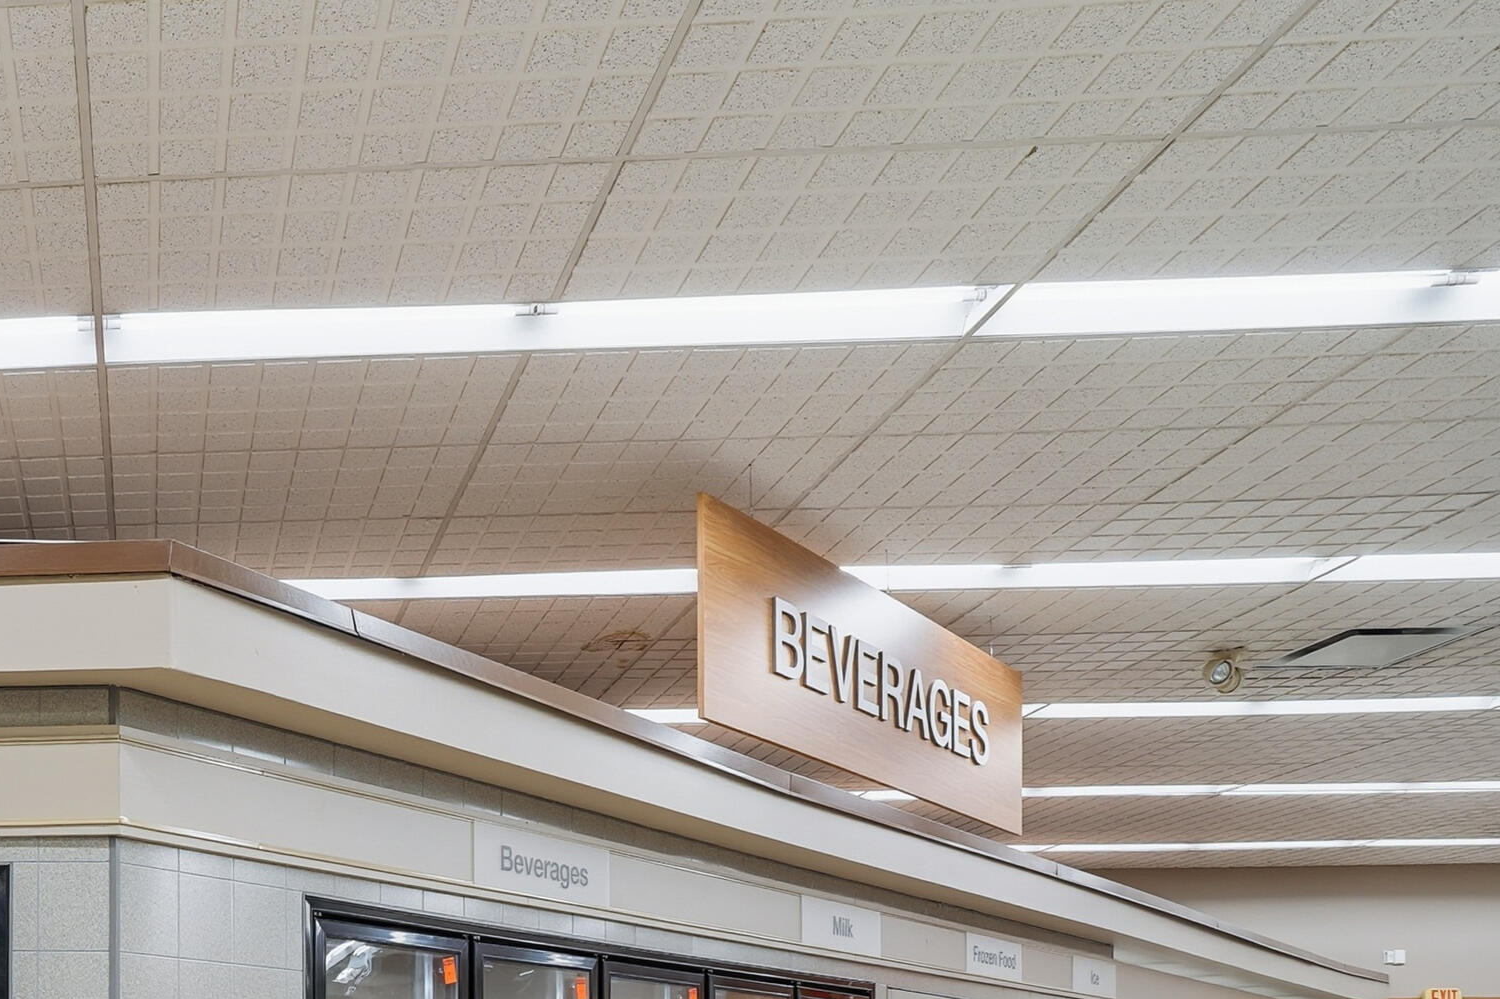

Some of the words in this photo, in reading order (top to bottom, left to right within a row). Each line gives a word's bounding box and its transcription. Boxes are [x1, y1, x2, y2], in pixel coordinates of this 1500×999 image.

[772, 596, 990, 766] BEVERAGES
[501, 845, 589, 889] Beverages
[832, 916, 853, 938] Milk
[973, 945, 998, 966] Frozen
[999, 951, 1017, 970] Food
